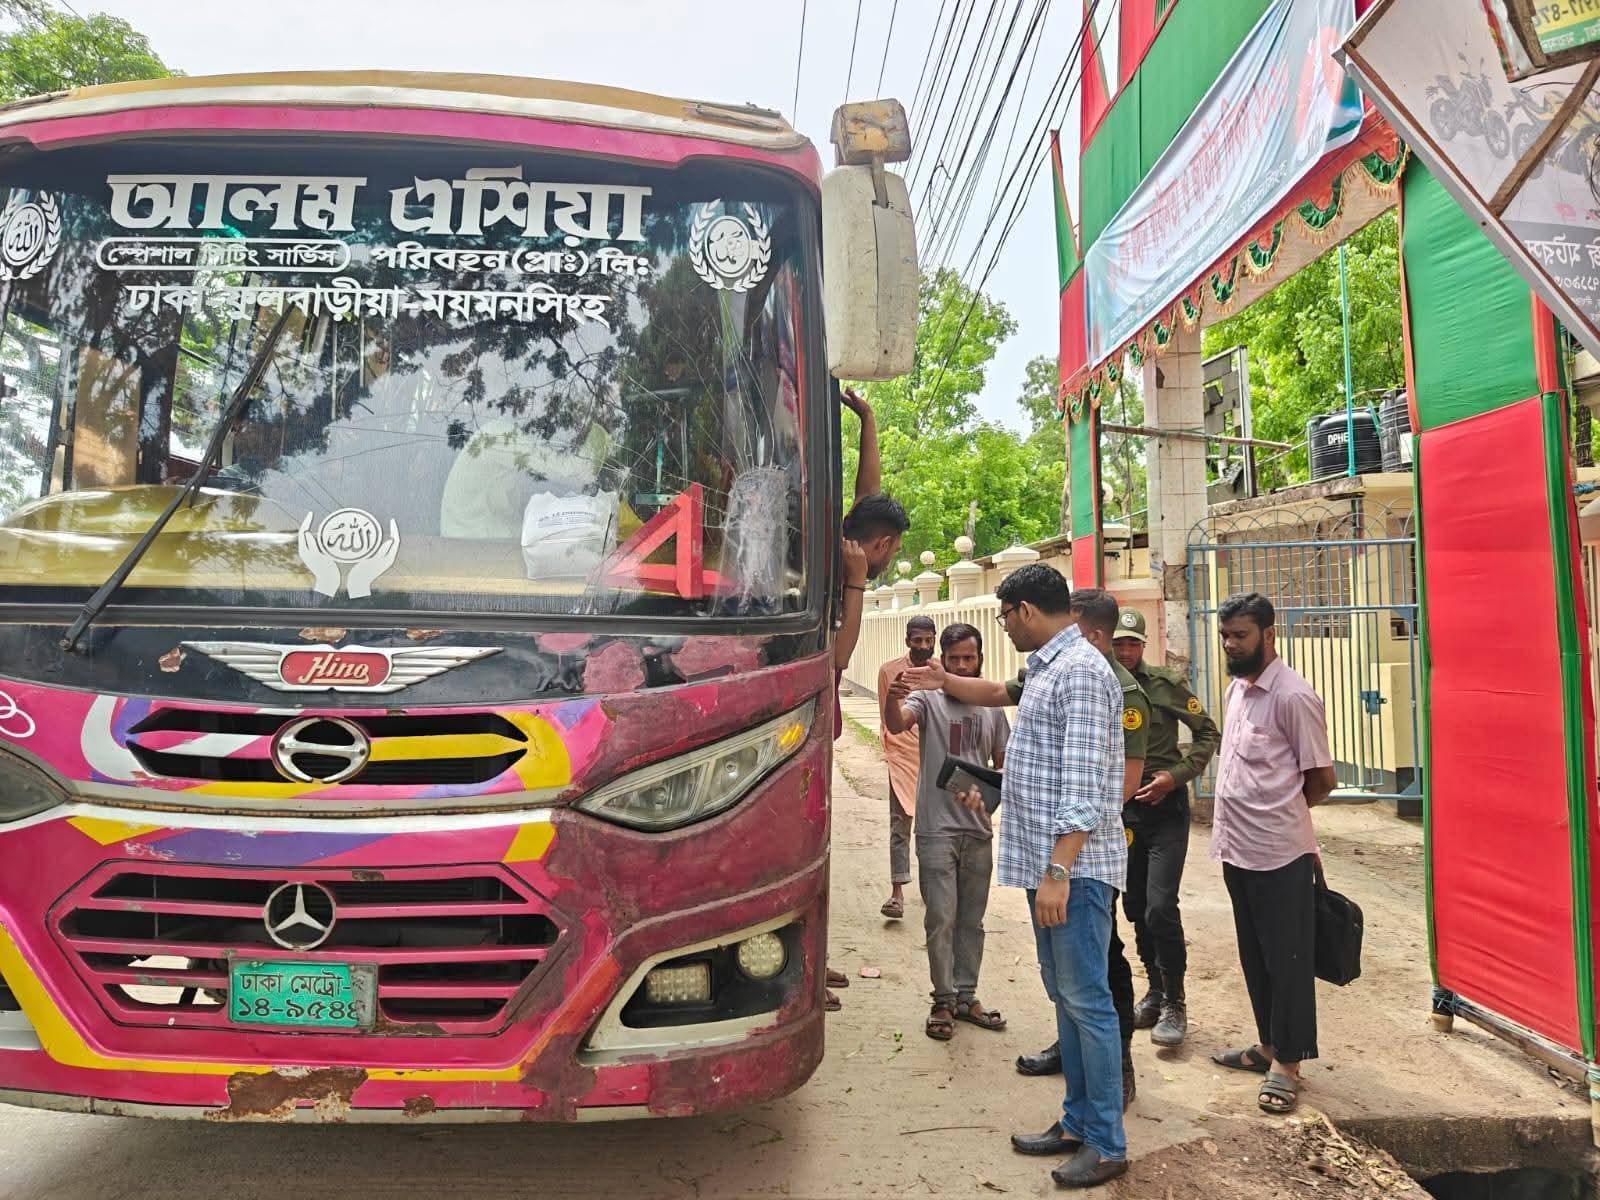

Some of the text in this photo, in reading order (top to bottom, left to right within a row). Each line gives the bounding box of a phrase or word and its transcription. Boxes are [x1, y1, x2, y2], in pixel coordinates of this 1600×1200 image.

[106, 174, 368, 232] আলম
[389, 165, 653, 248] এশিয়া
[107, 246, 195, 266] স্পেশাল
[266, 244, 338, 266] সার্ভিস
[375, 240, 508, 272] পরিবহন
[298, 653, 369, 684] Hino
[239, 973, 284, 994] ঢাকা
